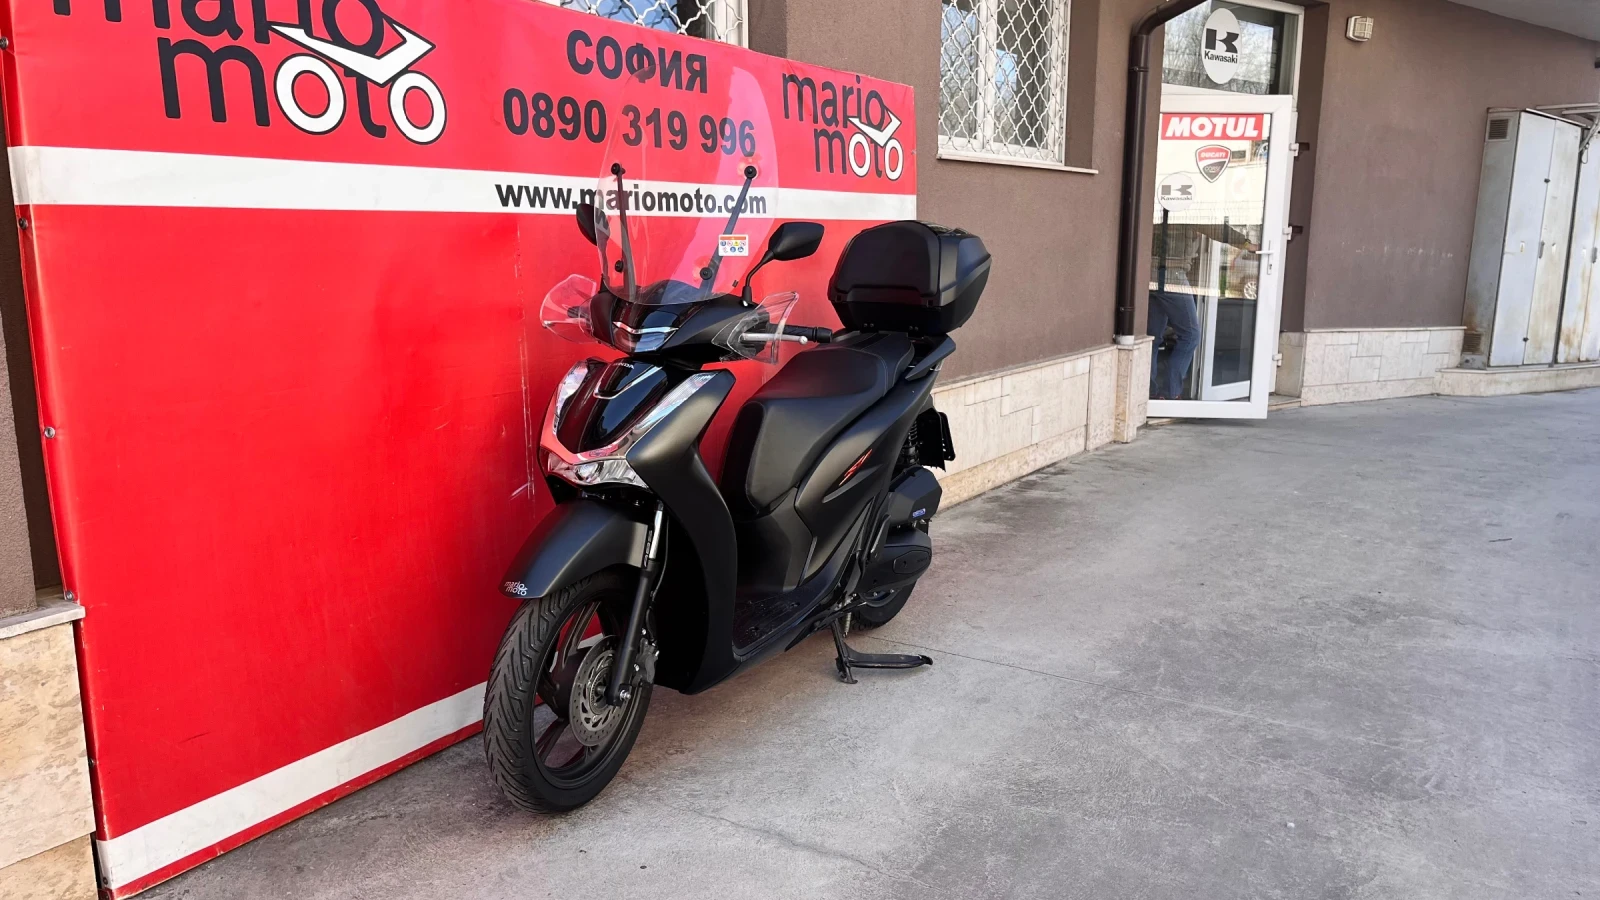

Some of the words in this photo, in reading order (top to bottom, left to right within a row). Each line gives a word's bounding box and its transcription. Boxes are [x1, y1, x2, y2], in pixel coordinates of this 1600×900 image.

[566, 30, 708, 94] СОФИЯ
[1204, 50, 1238, 64] Kawasaki
[157, 36, 448, 146] moto
[782, 74, 886, 132] mario
[503, 88, 607, 143] 0890
[621, 105, 688, 151] 319
[699, 115, 756, 157] 996
[1165, 116, 1258, 138] MOTUL
[813, 127, 904, 181] moto
